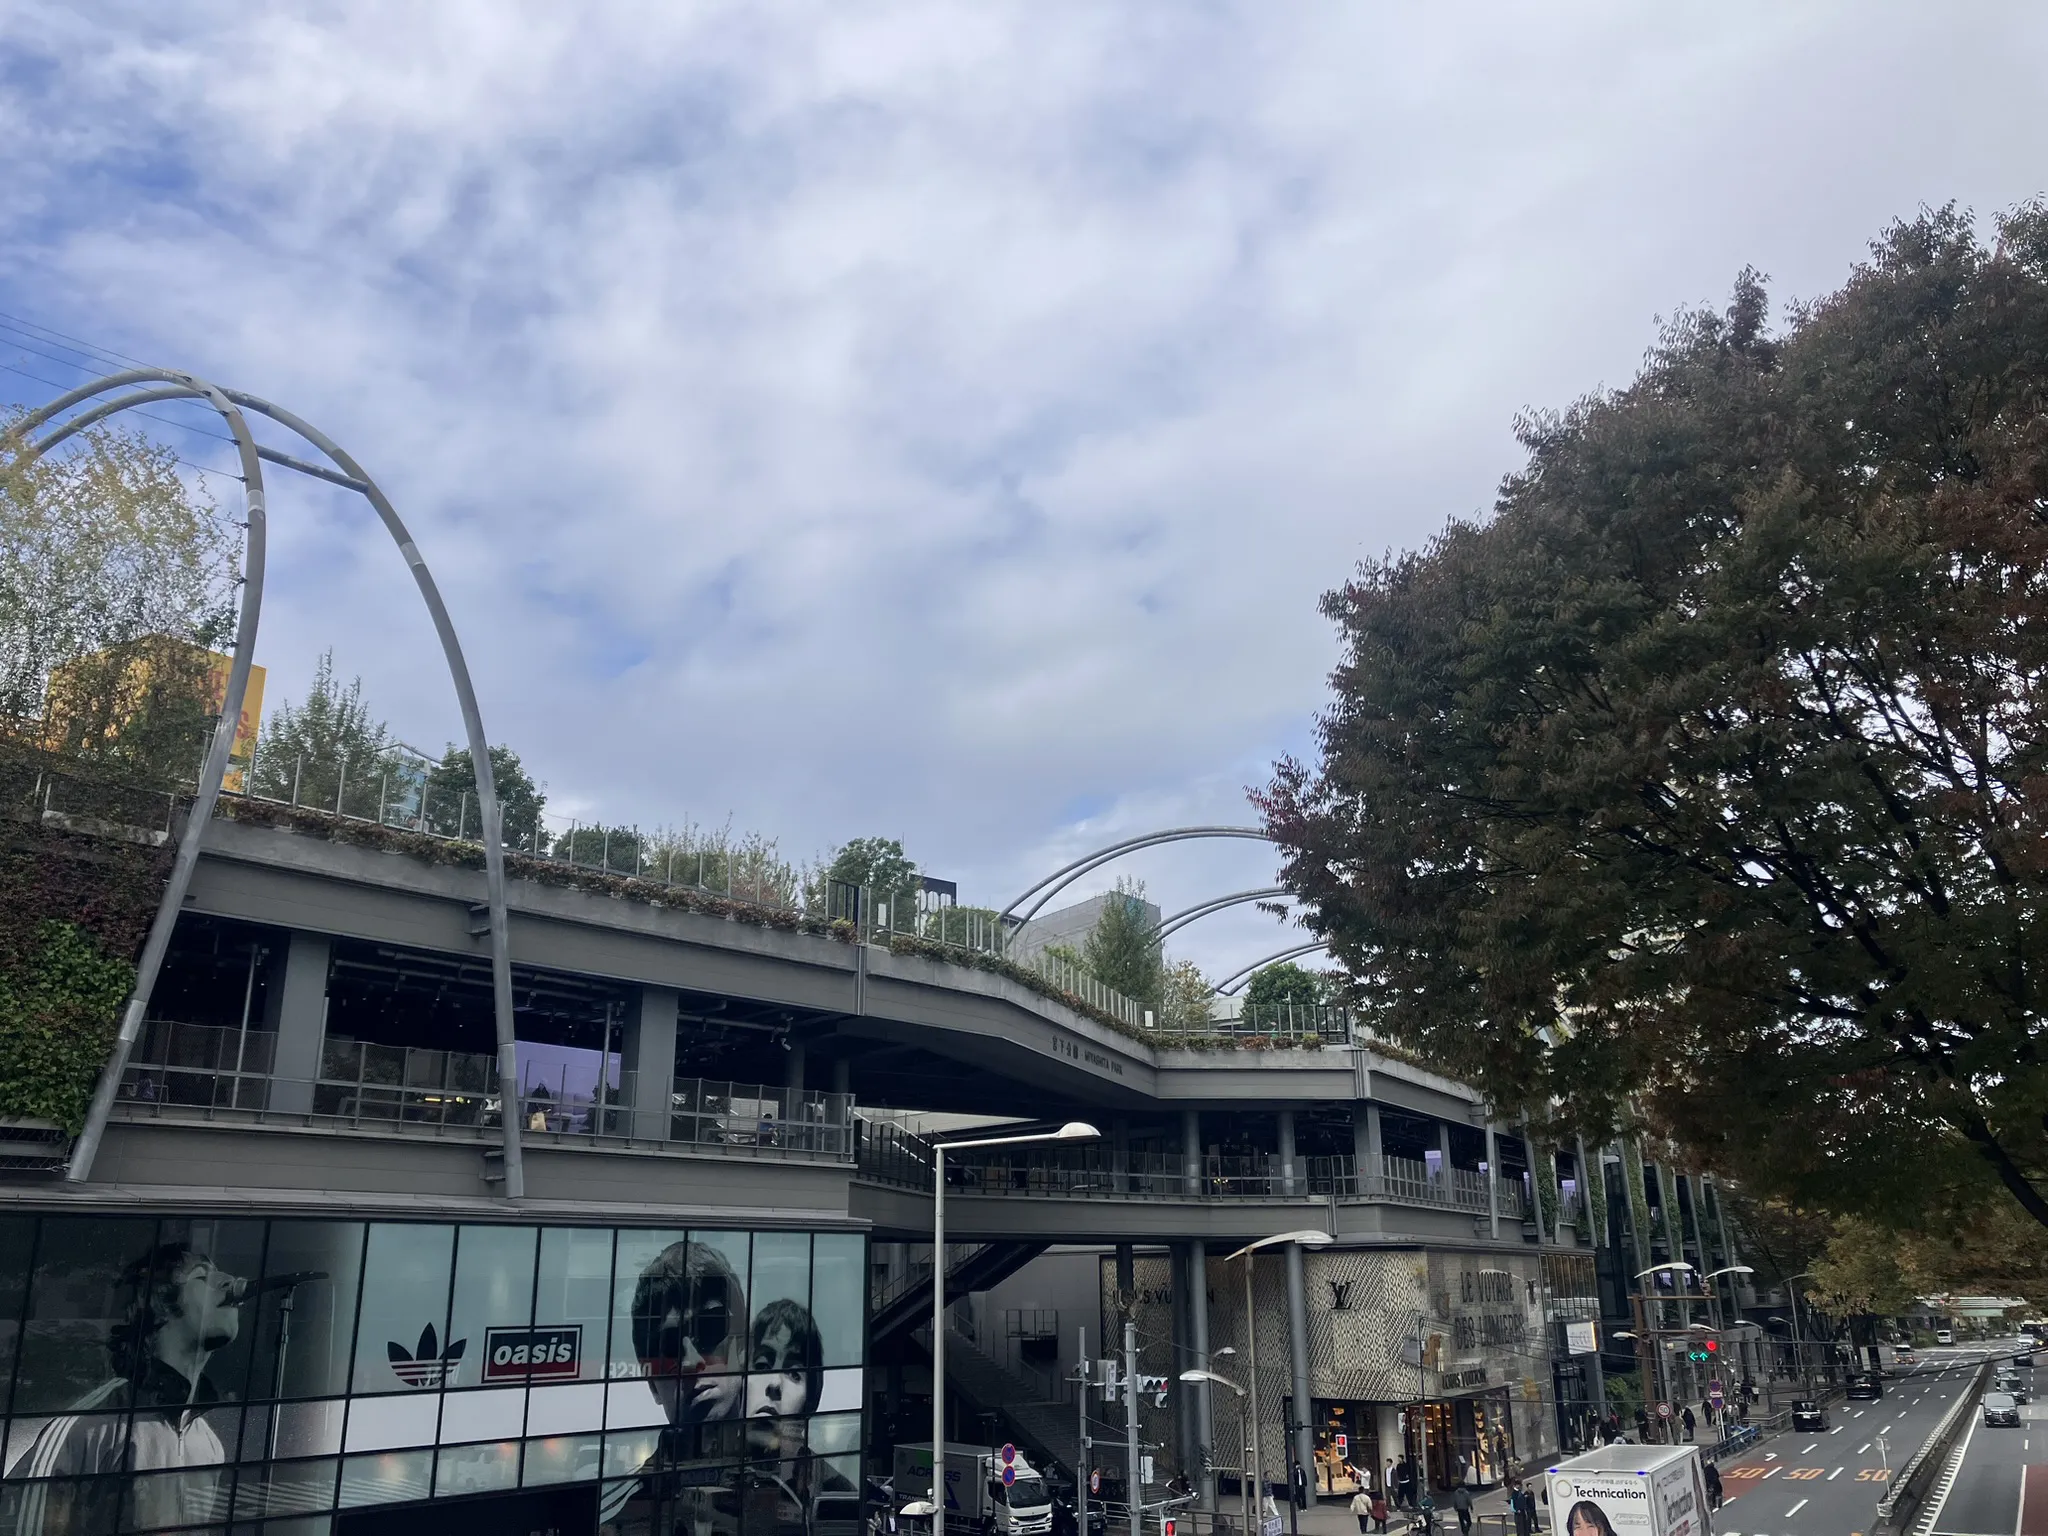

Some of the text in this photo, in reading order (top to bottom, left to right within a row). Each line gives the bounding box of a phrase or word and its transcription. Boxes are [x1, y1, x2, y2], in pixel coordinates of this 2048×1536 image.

[1461, 1272, 1515, 1303] LE VOYAGE
[1456, 1316, 1476, 1349] DES
[493, 1337, 573, 1366] oasis
[907, 1465, 962, 1482] ACRSS
[1724, 1467, 1766, 1479] 50
[1782, 1468, 1825, 1480] 50
[1854, 1468, 1892, 1481] 50
[1573, 1485, 1646, 1500] Technication
